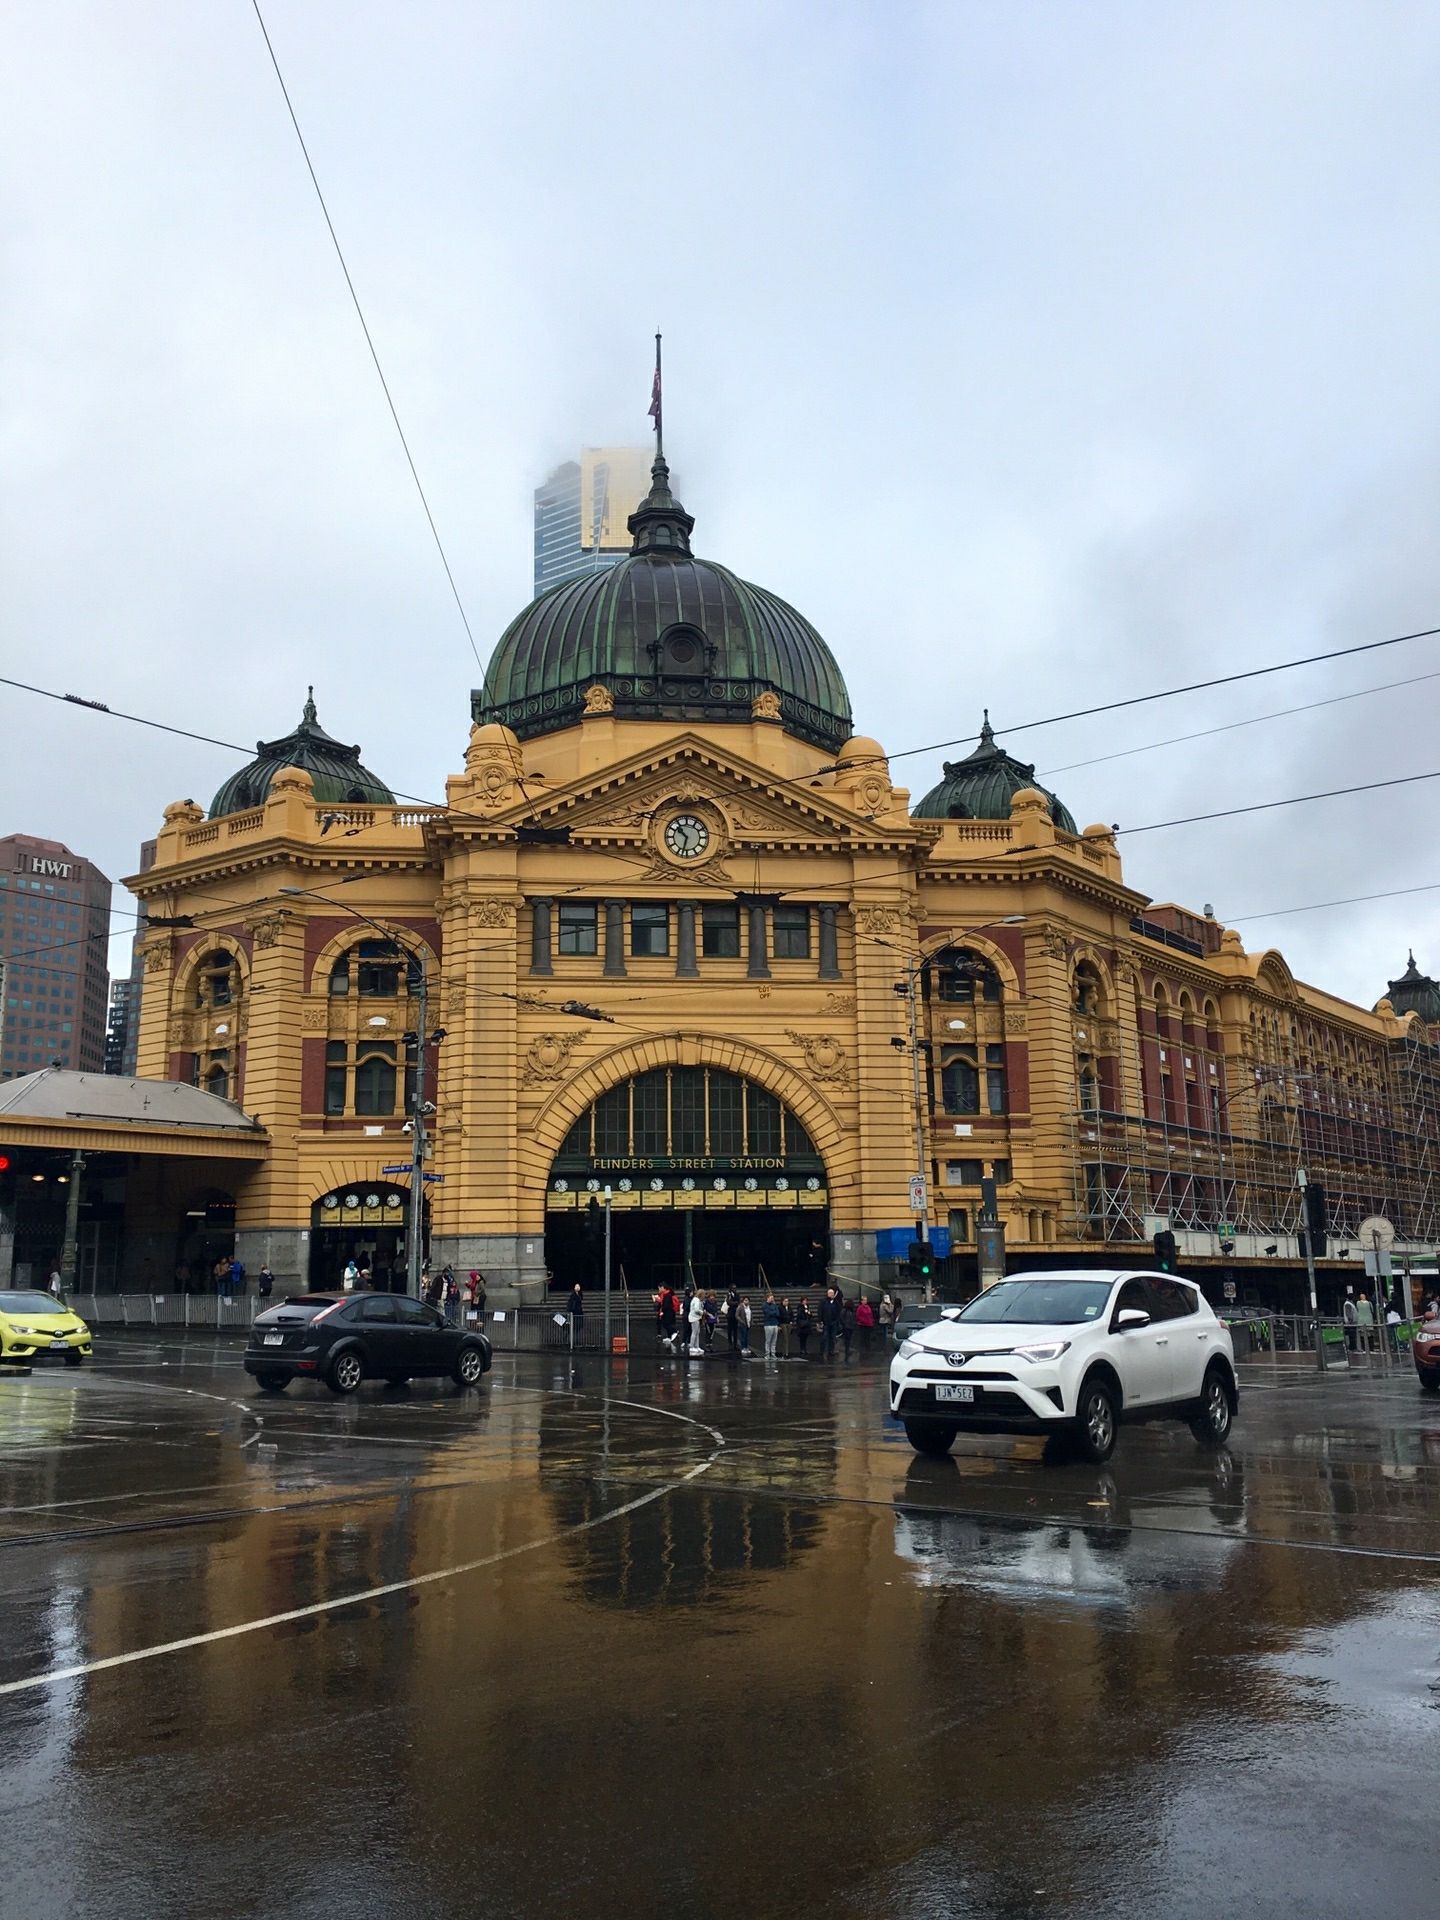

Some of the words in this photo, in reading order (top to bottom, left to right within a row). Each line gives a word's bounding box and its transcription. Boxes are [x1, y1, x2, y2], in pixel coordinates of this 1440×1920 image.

[32, 858, 72, 878] HWT
[593, 1158, 654, 1169] FLINDERS
[669, 1158, 716, 1169] STREET
[730, 1158, 785, 1169] STATION
